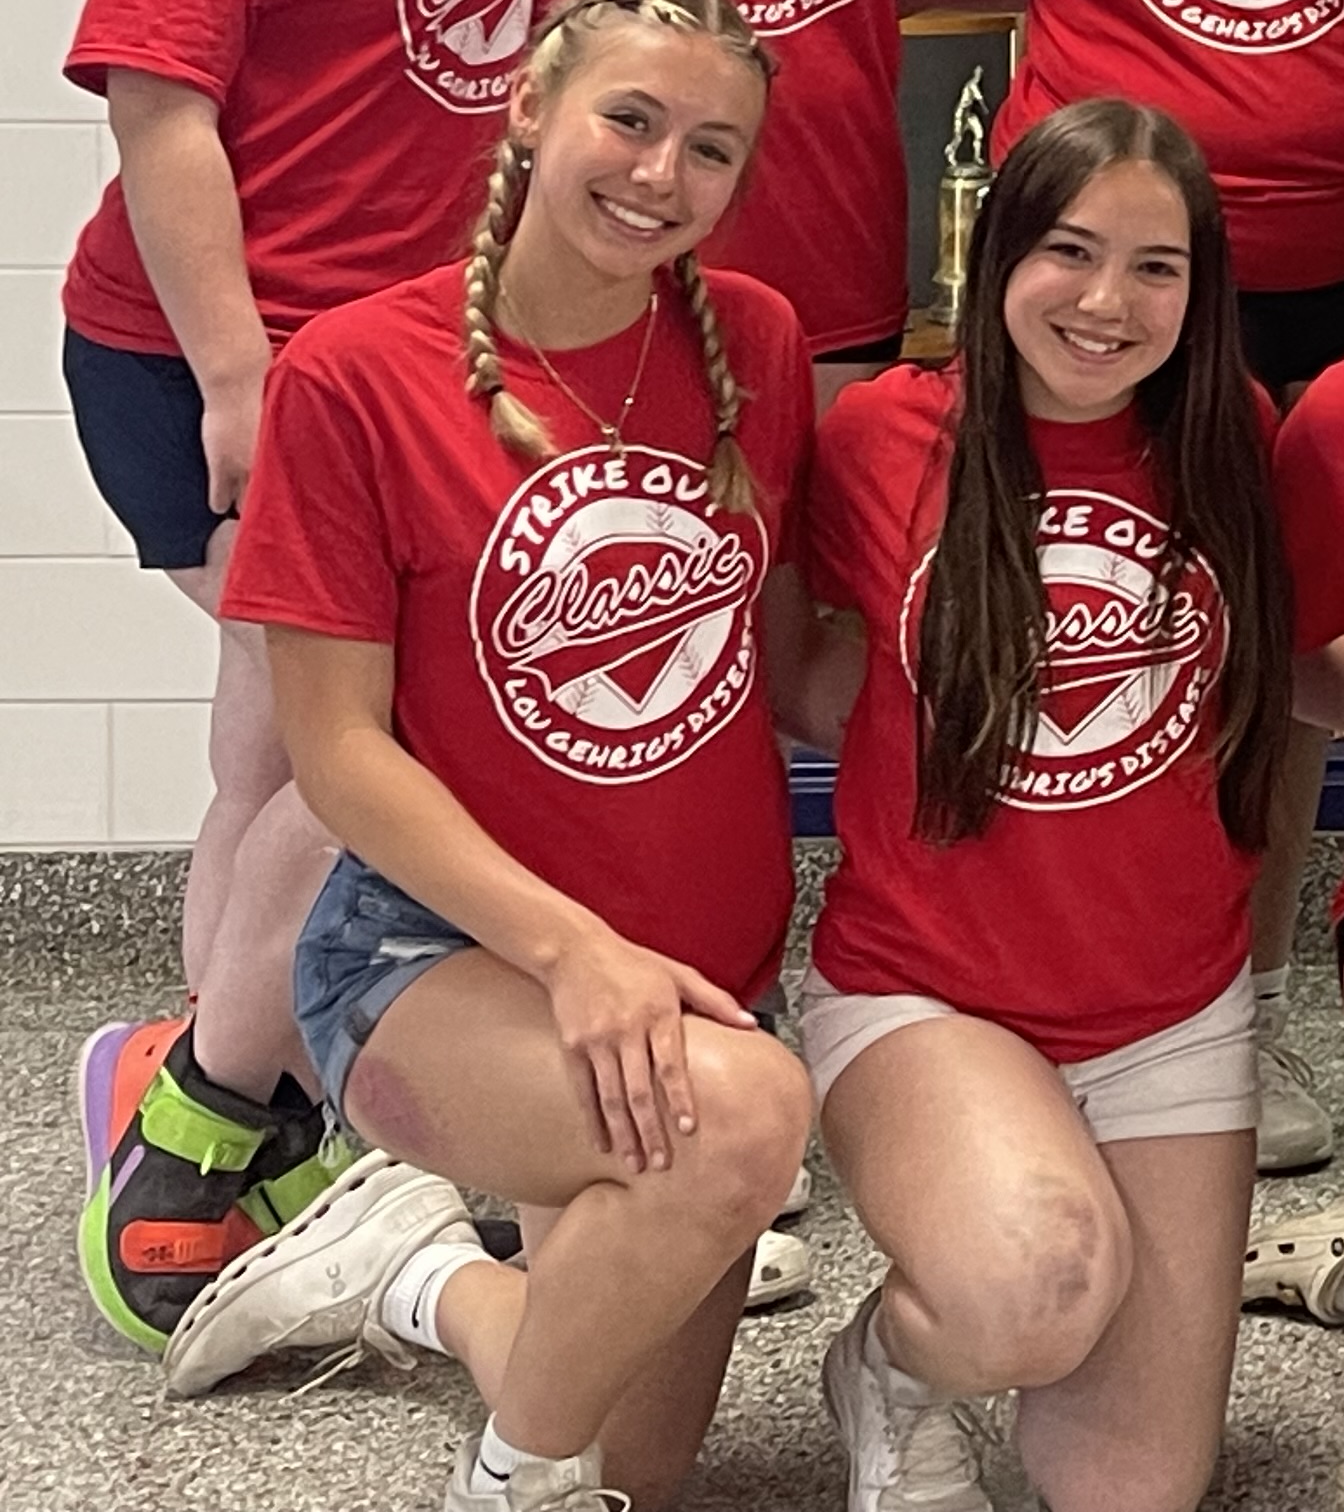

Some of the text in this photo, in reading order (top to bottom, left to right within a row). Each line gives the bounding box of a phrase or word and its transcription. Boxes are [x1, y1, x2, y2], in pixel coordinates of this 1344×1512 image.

[1180, 7, 1304, 42] GEHRIG'S
[500, 460, 719, 576] STRIKE OU
[492, 533, 740, 659] Classic
[503, 678, 552, 730] LOU
[545, 724, 686, 770] GEHRIG'S
